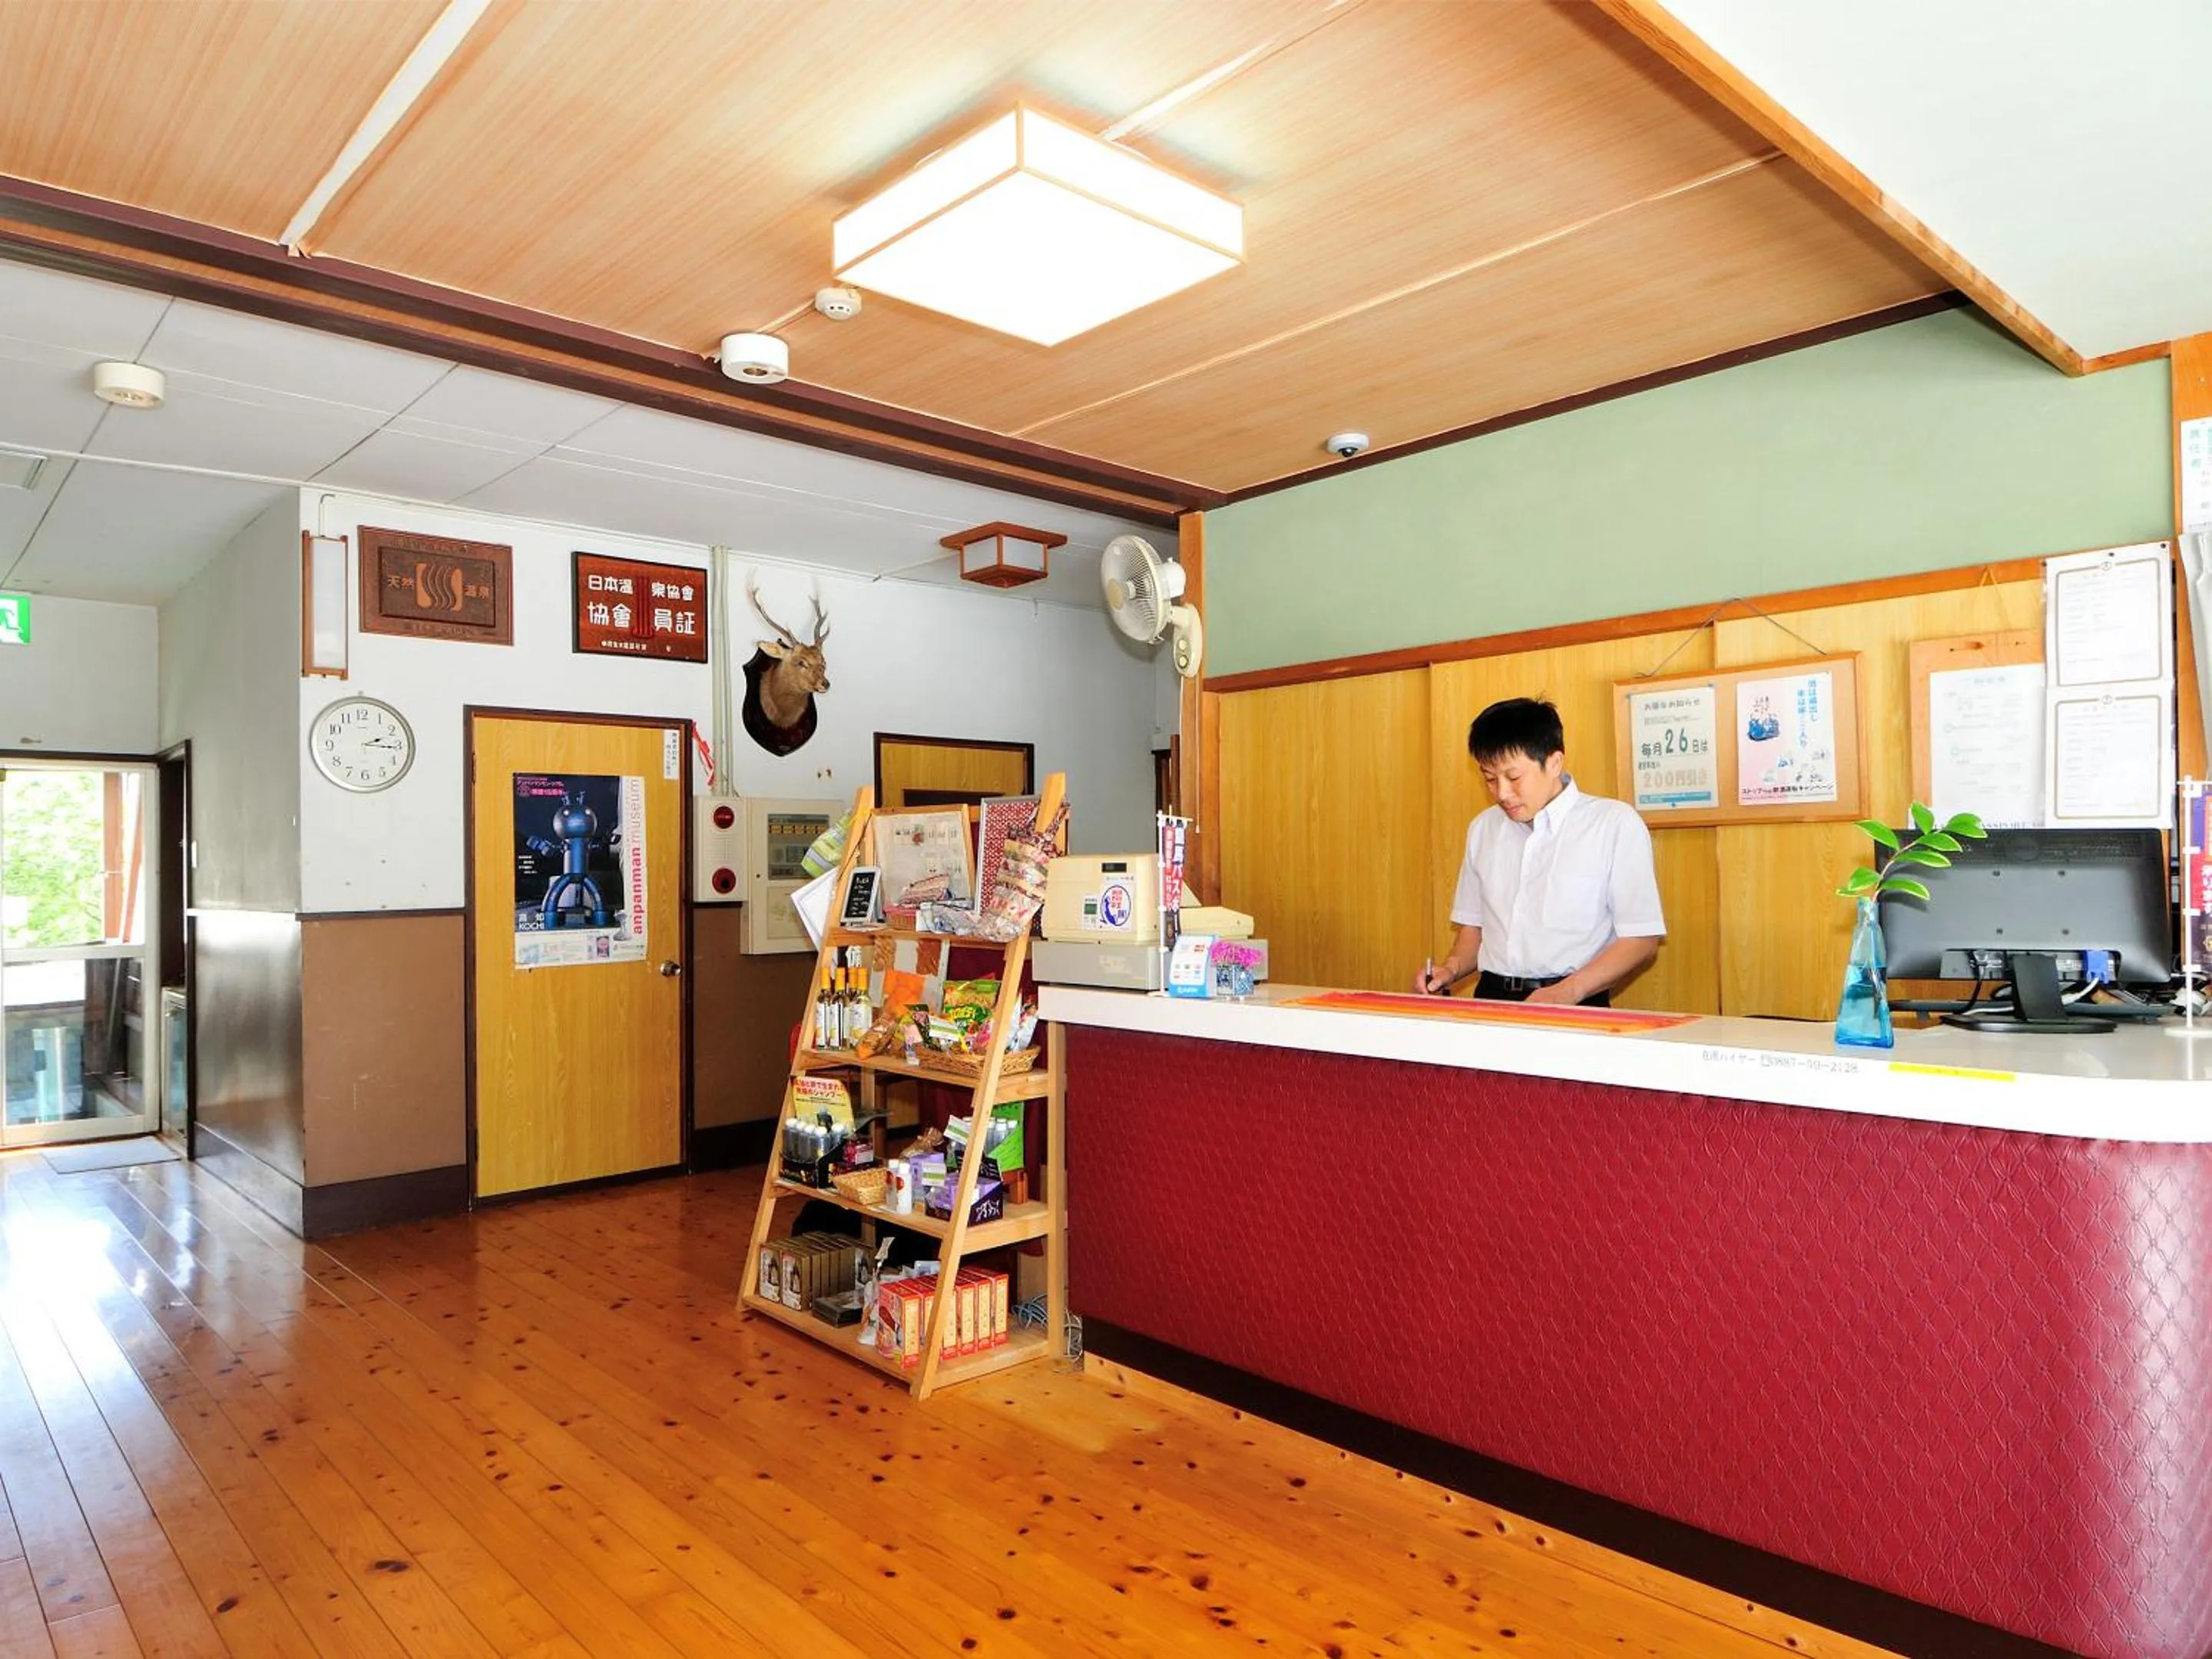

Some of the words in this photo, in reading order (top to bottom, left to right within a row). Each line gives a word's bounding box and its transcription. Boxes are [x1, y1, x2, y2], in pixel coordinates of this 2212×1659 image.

[654, 608, 695, 634] 員証
[1641, 727, 1708, 757] 毎月26日は
[631, 779, 641, 843] museum
[631, 846, 644, 935] anpanman
[518, 922, 545, 930] KOCHI
